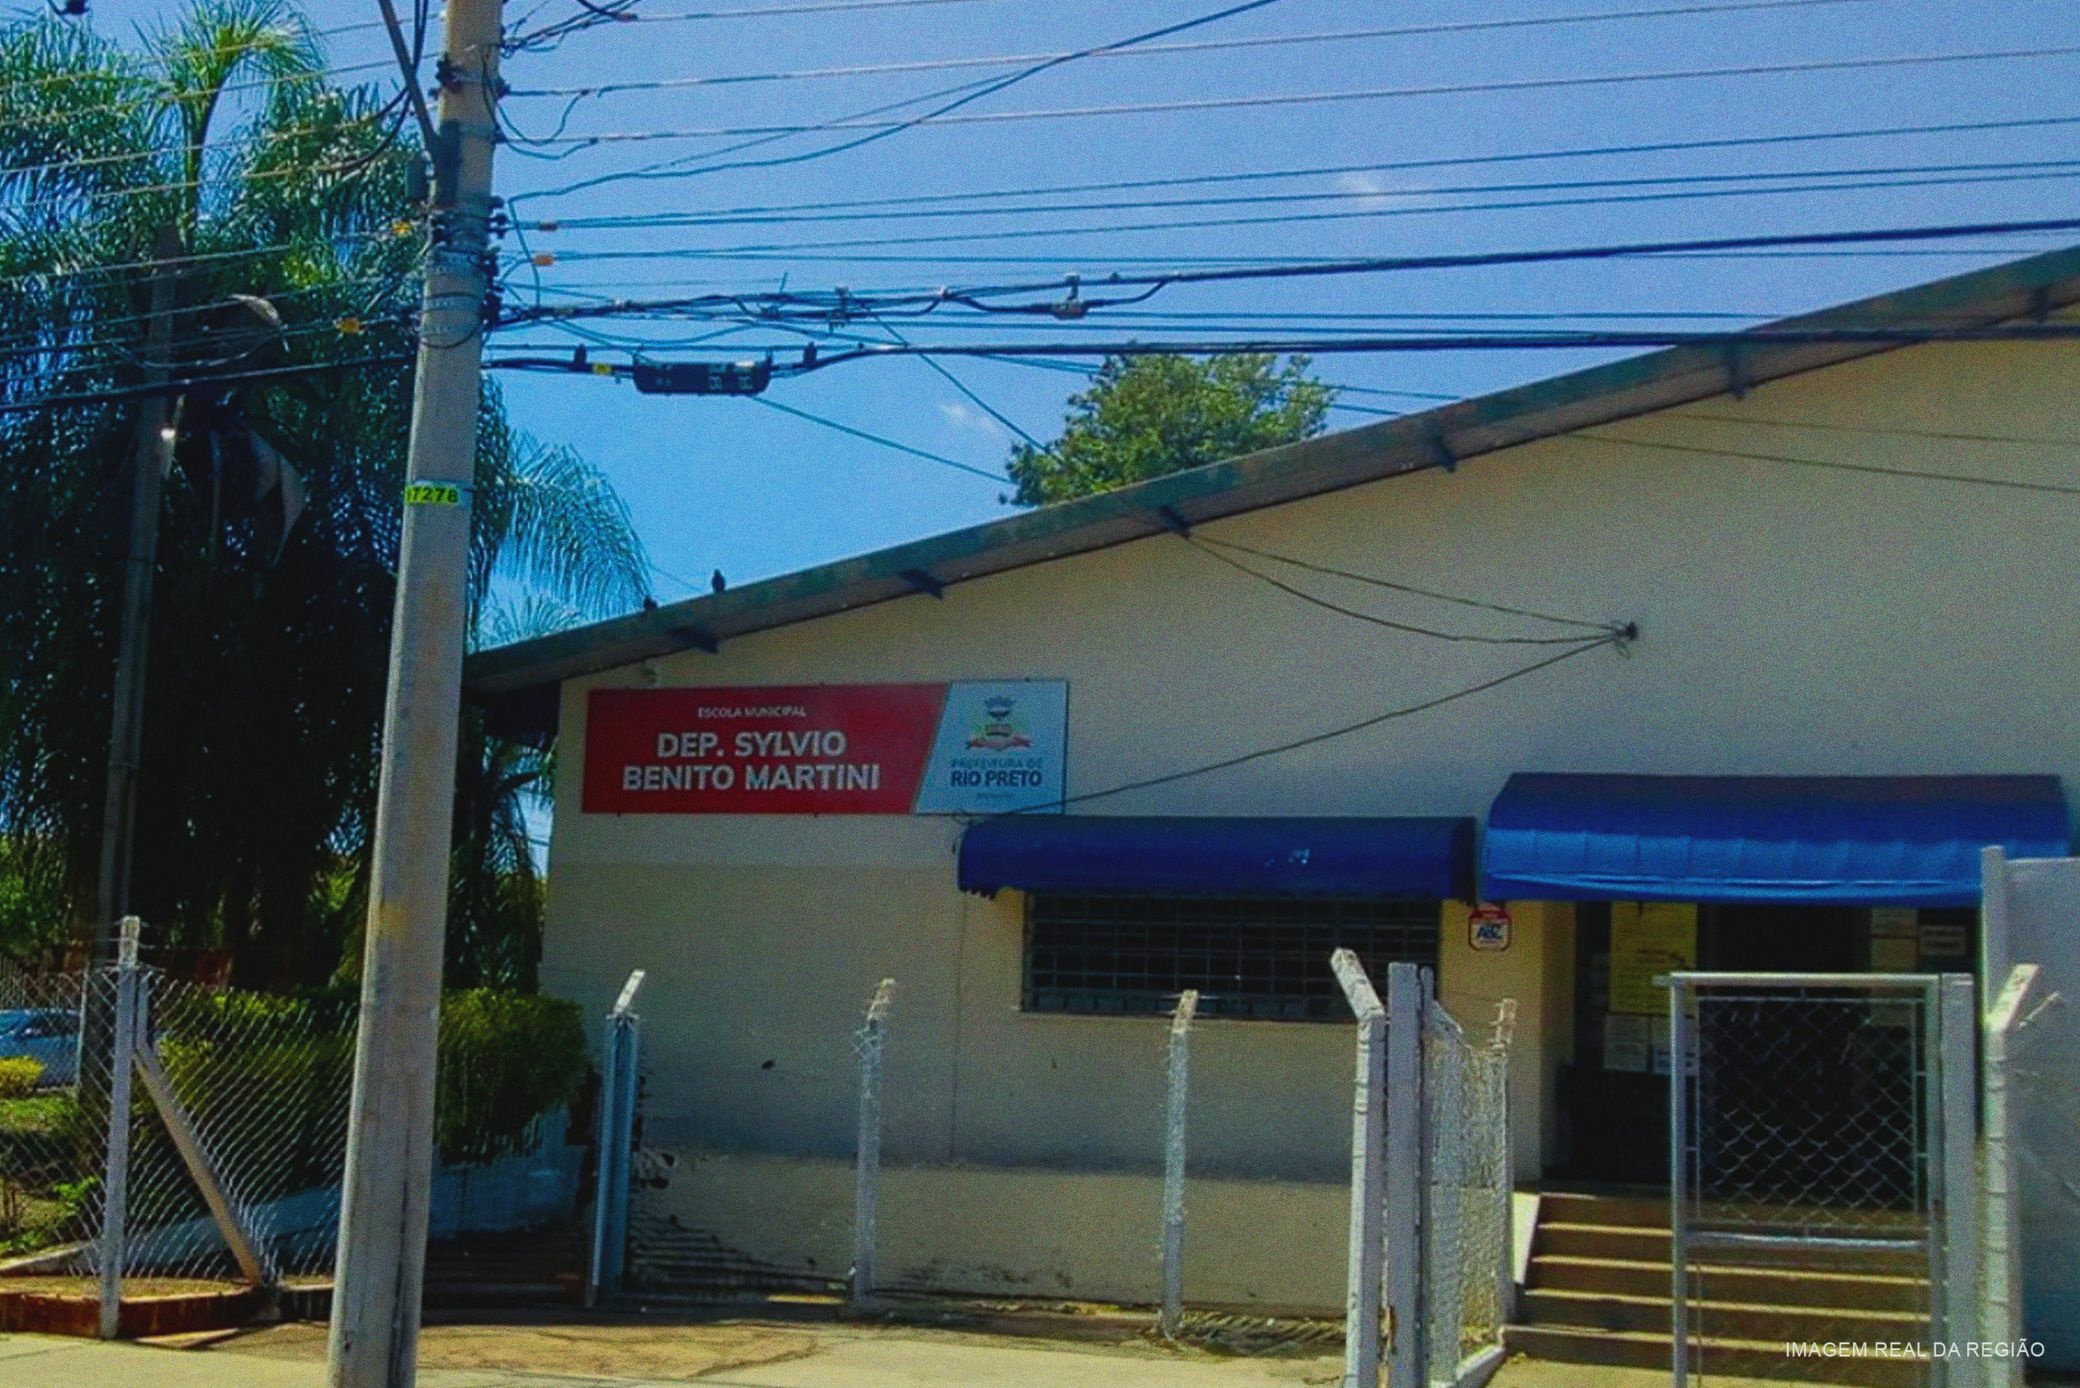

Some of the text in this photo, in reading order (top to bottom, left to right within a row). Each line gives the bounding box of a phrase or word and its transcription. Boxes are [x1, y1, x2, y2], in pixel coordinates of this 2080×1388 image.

[698, 705, 807, 718] ESCOLA MUNICIPAL
[657, 731, 848, 757] DEP. SYLVIO
[623, 764, 880, 790] BENITO MARTINI
[950, 770, 1043, 787] RIO PRETO
